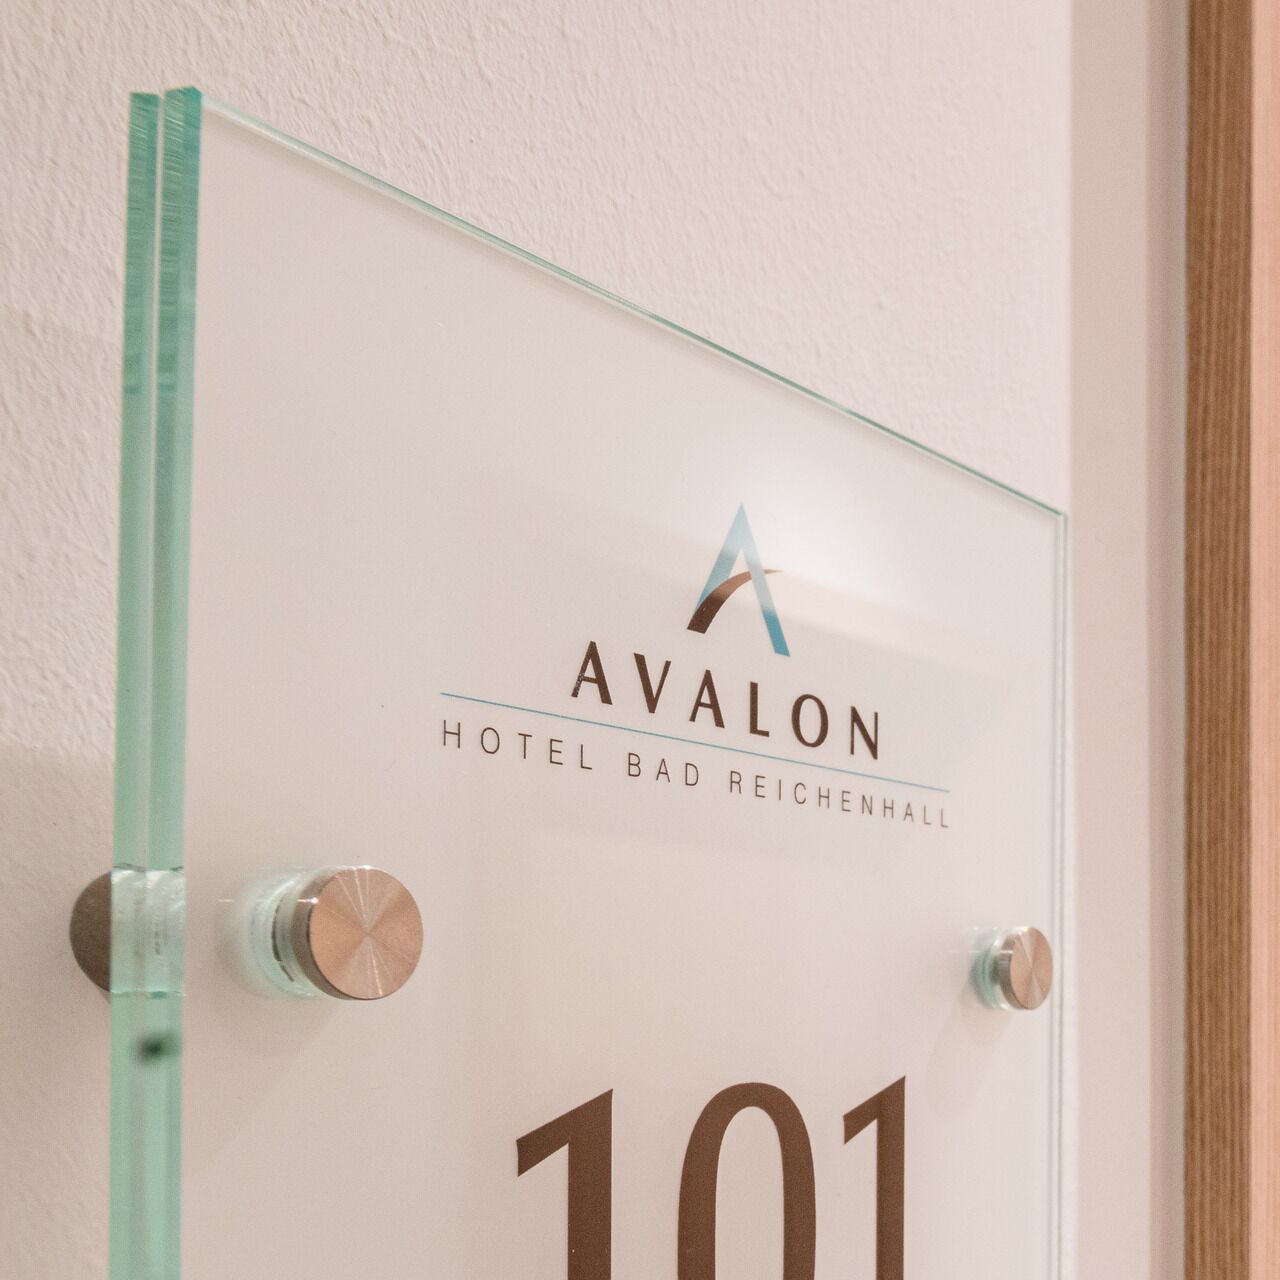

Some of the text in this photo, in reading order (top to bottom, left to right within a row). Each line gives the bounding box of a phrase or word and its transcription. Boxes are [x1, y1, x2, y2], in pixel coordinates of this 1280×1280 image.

[570, 640, 880, 761] AVALON
[442, 718, 950, 829] HOTEL BAD REICHENHALL
